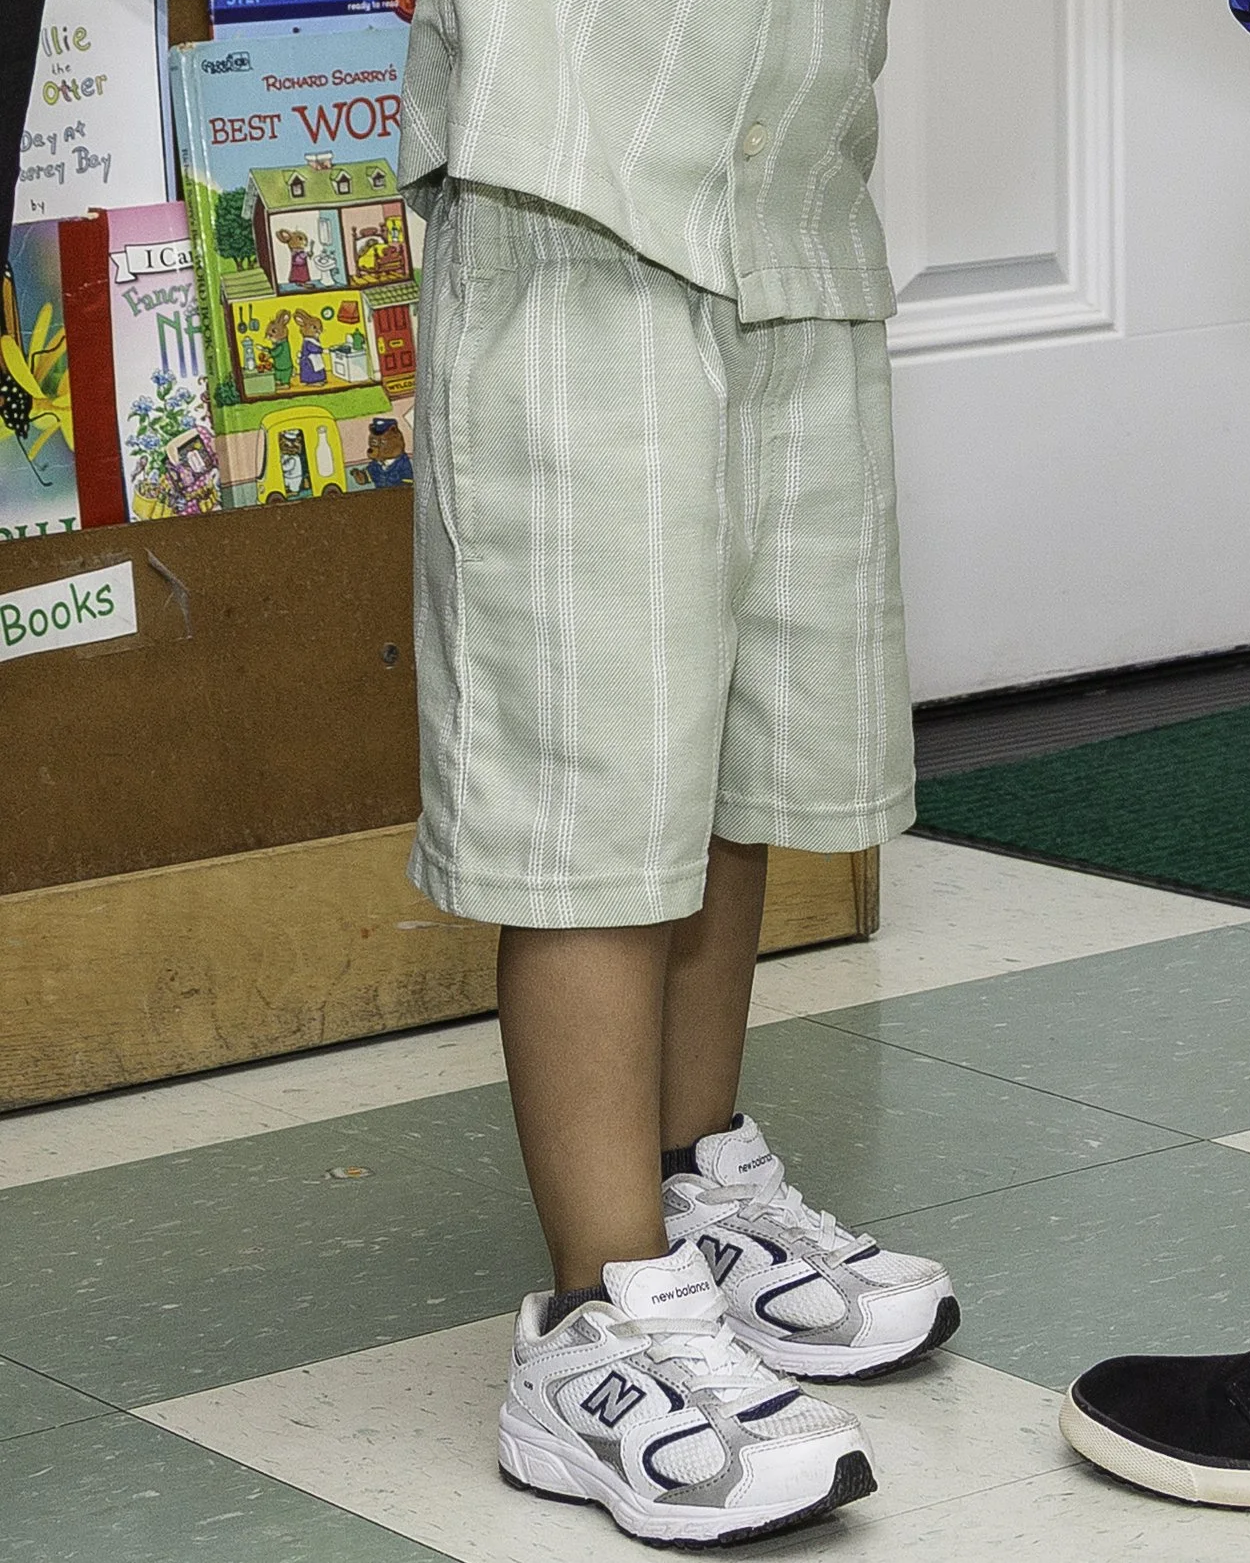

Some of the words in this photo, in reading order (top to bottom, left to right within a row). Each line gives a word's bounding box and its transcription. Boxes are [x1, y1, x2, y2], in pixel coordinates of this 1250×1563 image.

[347, 0, 371, 12] ready
[371, 0, 381, 9] to
[40, 26, 91, 57] llie
[52, 63, 72, 76] the
[262, 75, 328, 91] RICHARD
[42, 74, 107, 105] Otter
[209, 114, 281, 144] BEST
[291, 94, 401, 144] WOR
[20, 130, 57, 155] Day
[72, 146, 112, 183] Bay
[30, 198, 45, 214] by
[144, 250, 154, 268] I
[122, 283, 192, 317] Fancy
[199, 305, 216, 351] BOOK
[388, 381, 416, 391] WELCO
[0, 583, 115, 646] Books
[651, 1290, 675, 1305] new
[675, 1281, 710, 1299] balance
[580, 1370, 647, 1428] N
